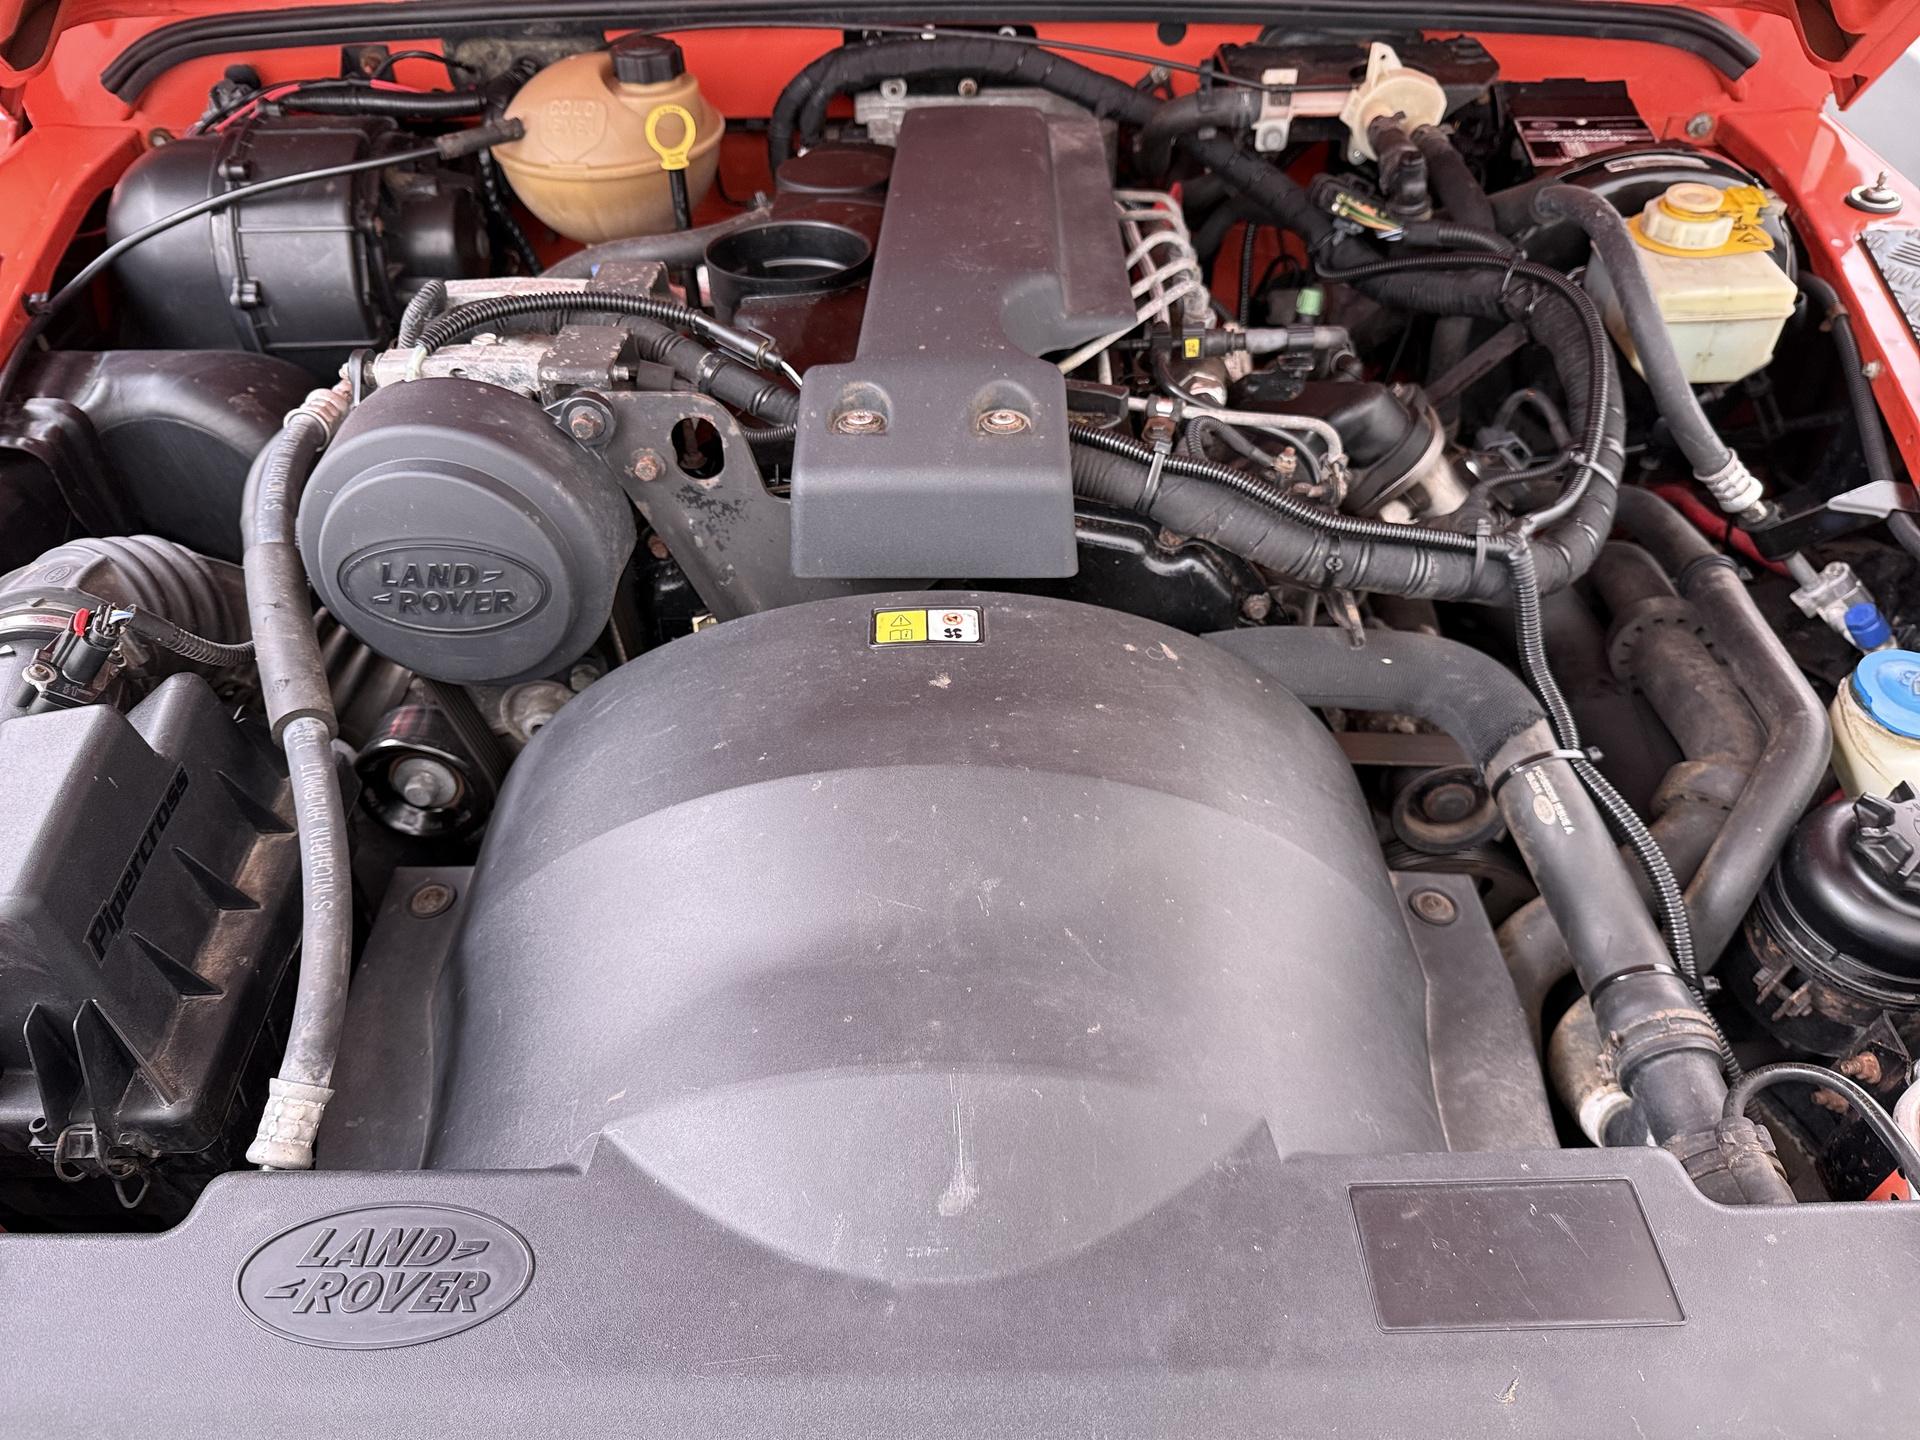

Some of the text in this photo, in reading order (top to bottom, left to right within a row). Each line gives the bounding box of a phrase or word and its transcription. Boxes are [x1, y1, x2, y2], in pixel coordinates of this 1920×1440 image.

[381, 562, 479, 589] LAND
[398, 588, 519, 616] ROVER
[86, 763, 189, 964] Pipercross
[296, 1227, 457, 1267] LAND
[291, 1270, 492, 1314] ROVER
